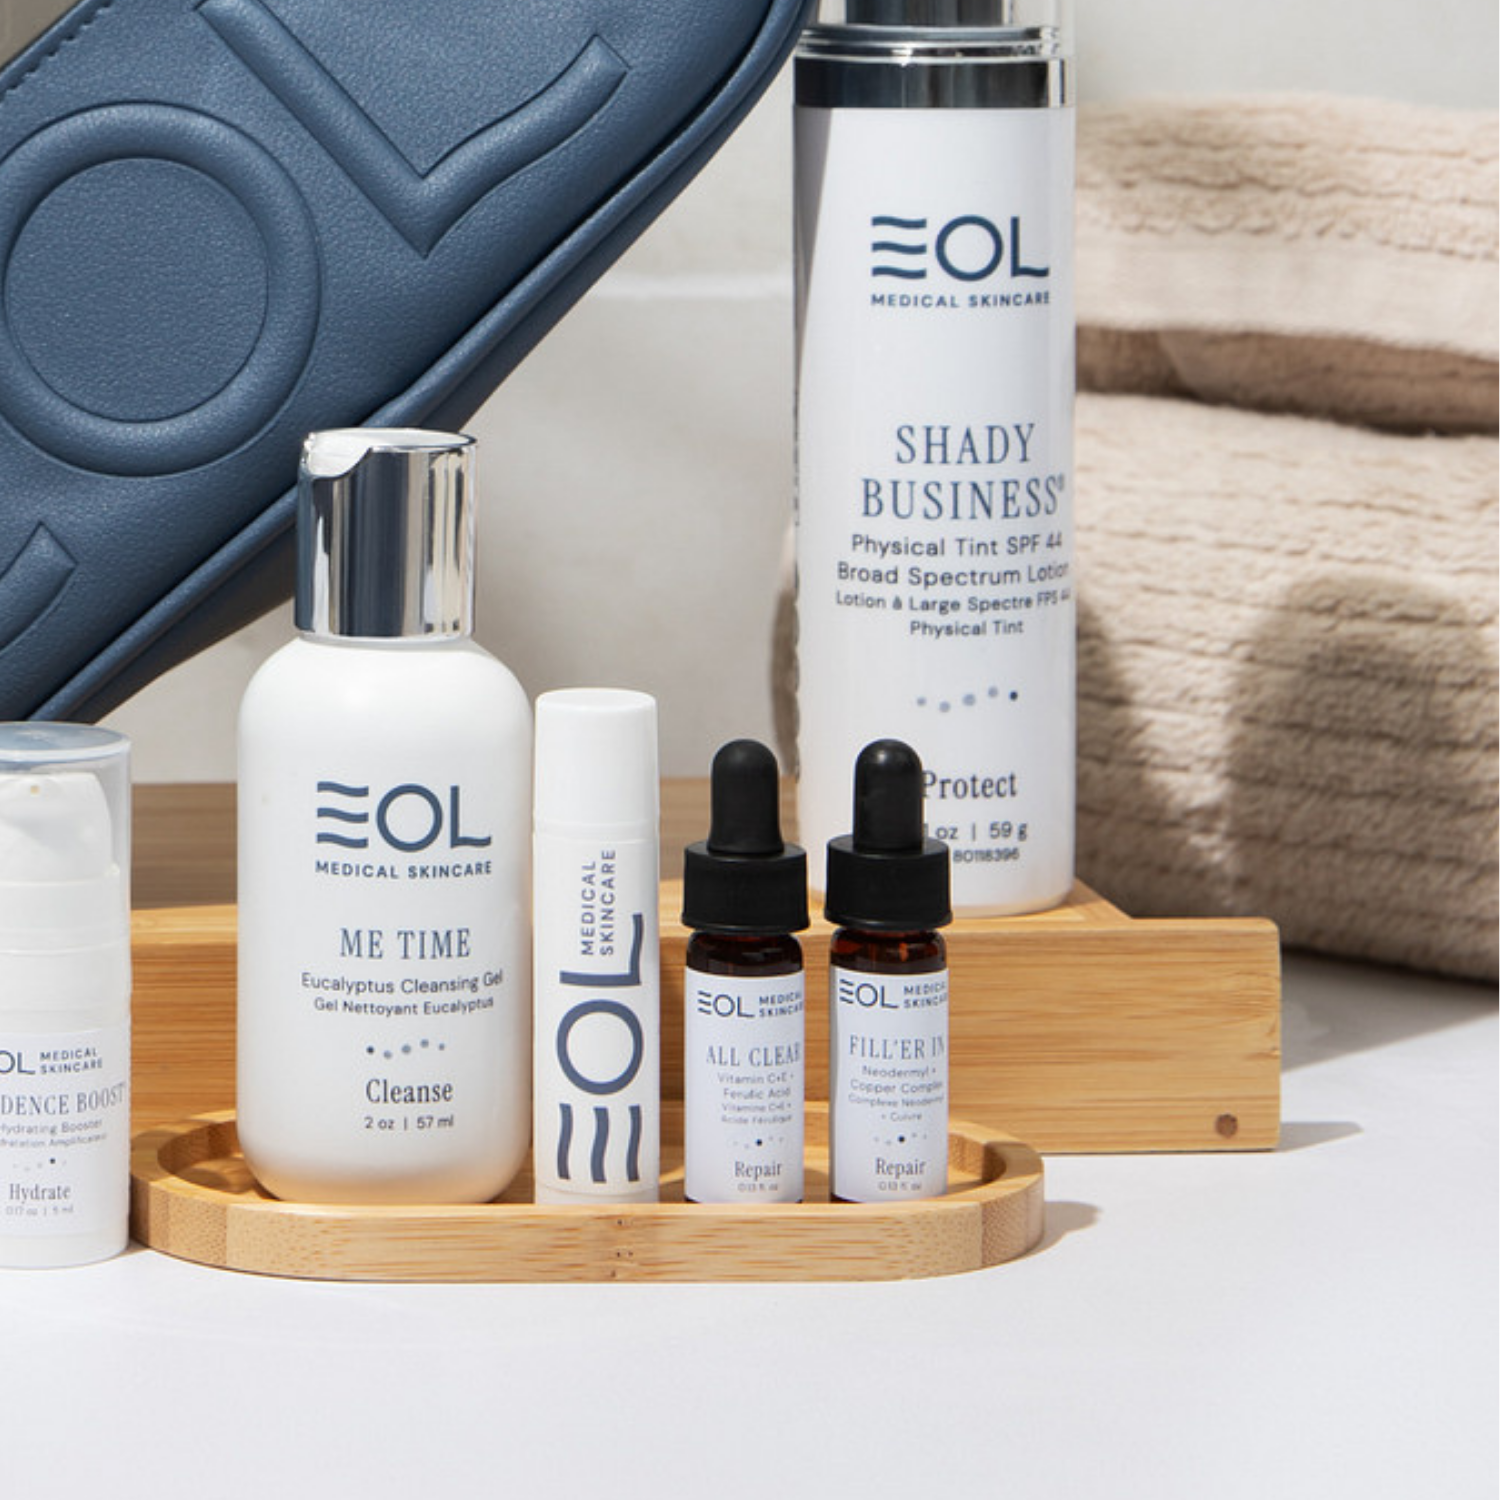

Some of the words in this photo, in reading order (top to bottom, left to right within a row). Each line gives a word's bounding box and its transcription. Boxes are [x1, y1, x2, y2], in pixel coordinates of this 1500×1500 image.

[871, 214, 1050, 282] EOL
[871, 293, 960, 309] MEDICAL
[968, 291, 1050, 307] SKINCARE
[895, 423, 1036, 465] SHADY
[852, 534, 945, 558] Physical
[955, 537, 999, 556] Tint
[1006, 534, 1040, 555] SPF
[837, 561, 898, 584] Broad
[908, 566, 1021, 589] Spectrum
[836, 590, 887, 608] Lotion
[909, 596, 960, 615] Large
[967, 595, 1033, 613] Spectre
[910, 620, 987, 639] Physical
[993, 620, 1024, 635] Tint
[922, 770, 1017, 799] Protect
[316, 781, 492, 852] EOL
[935, 827, 958, 840] oz
[989, 821, 1012, 839] 59
[1017, 823, 1028, 842] g
[315, 860, 399, 880] MEDICAL
[407, 860, 493, 879] SKINCARE
[581, 861, 596, 956] MEDICAL
[600, 850, 616, 956] SKINCARE
[339, 927, 384, 960] ME
[397, 927, 472, 960] TIME
[301, 972, 394, 996] Eucalyptus
[401, 975, 479, 994] Cleansing
[483, 968, 503, 987] Gel
[839, 978, 899, 1009] EOL
[314, 997, 338, 1012] Gel
[343, 1001, 418, 1017] Nettoyant
[423, 996, 493, 1015] Eucalyptus
[698, 990, 755, 1018] EOL
[40, 1047, 98, 1062] MEDICAL
[556, 913, 645, 1184] EOL
[706, 1045, 740, 1066] ALL
[40, 1057, 103, 1075] SKINCARE
[717, 1072, 764, 1084] Vitamin
[850, 1078, 896, 1094] Copper
[366, 1078, 453, 1104] Cleanse
[768, 1087, 791, 1099] Acid
[364, 1116, 374, 1129] 2
[377, 1119, 395, 1130] oz
[417, 1115, 434, 1129] 57
[437, 1114, 454, 1128] ml
[735, 1160, 782, 1181] Repair
[875, 1157, 927, 1180] Repair
[10, 1183, 71, 1205] Hydrate
